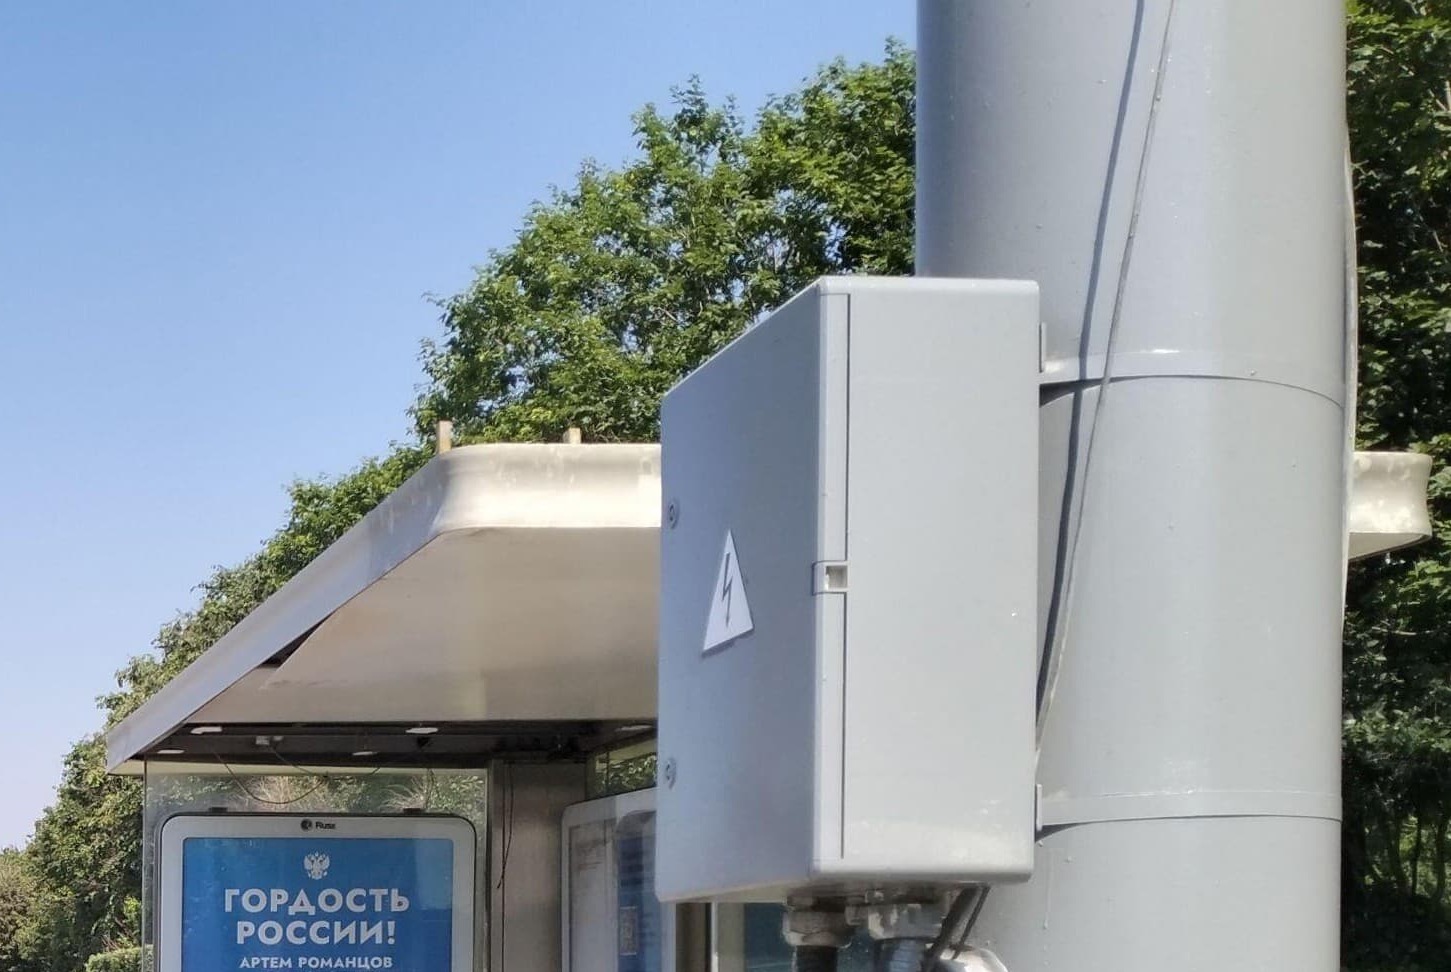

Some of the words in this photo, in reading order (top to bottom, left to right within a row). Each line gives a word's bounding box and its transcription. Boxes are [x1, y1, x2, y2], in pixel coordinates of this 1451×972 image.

[224, 888, 410, 916] ГОРДОСТЬ
[236, 920, 396, 945] РОССИИ!
[239, 956, 293, 969] АРТЕМ
[298, 956, 393, 970] РОМАНЦОВ
